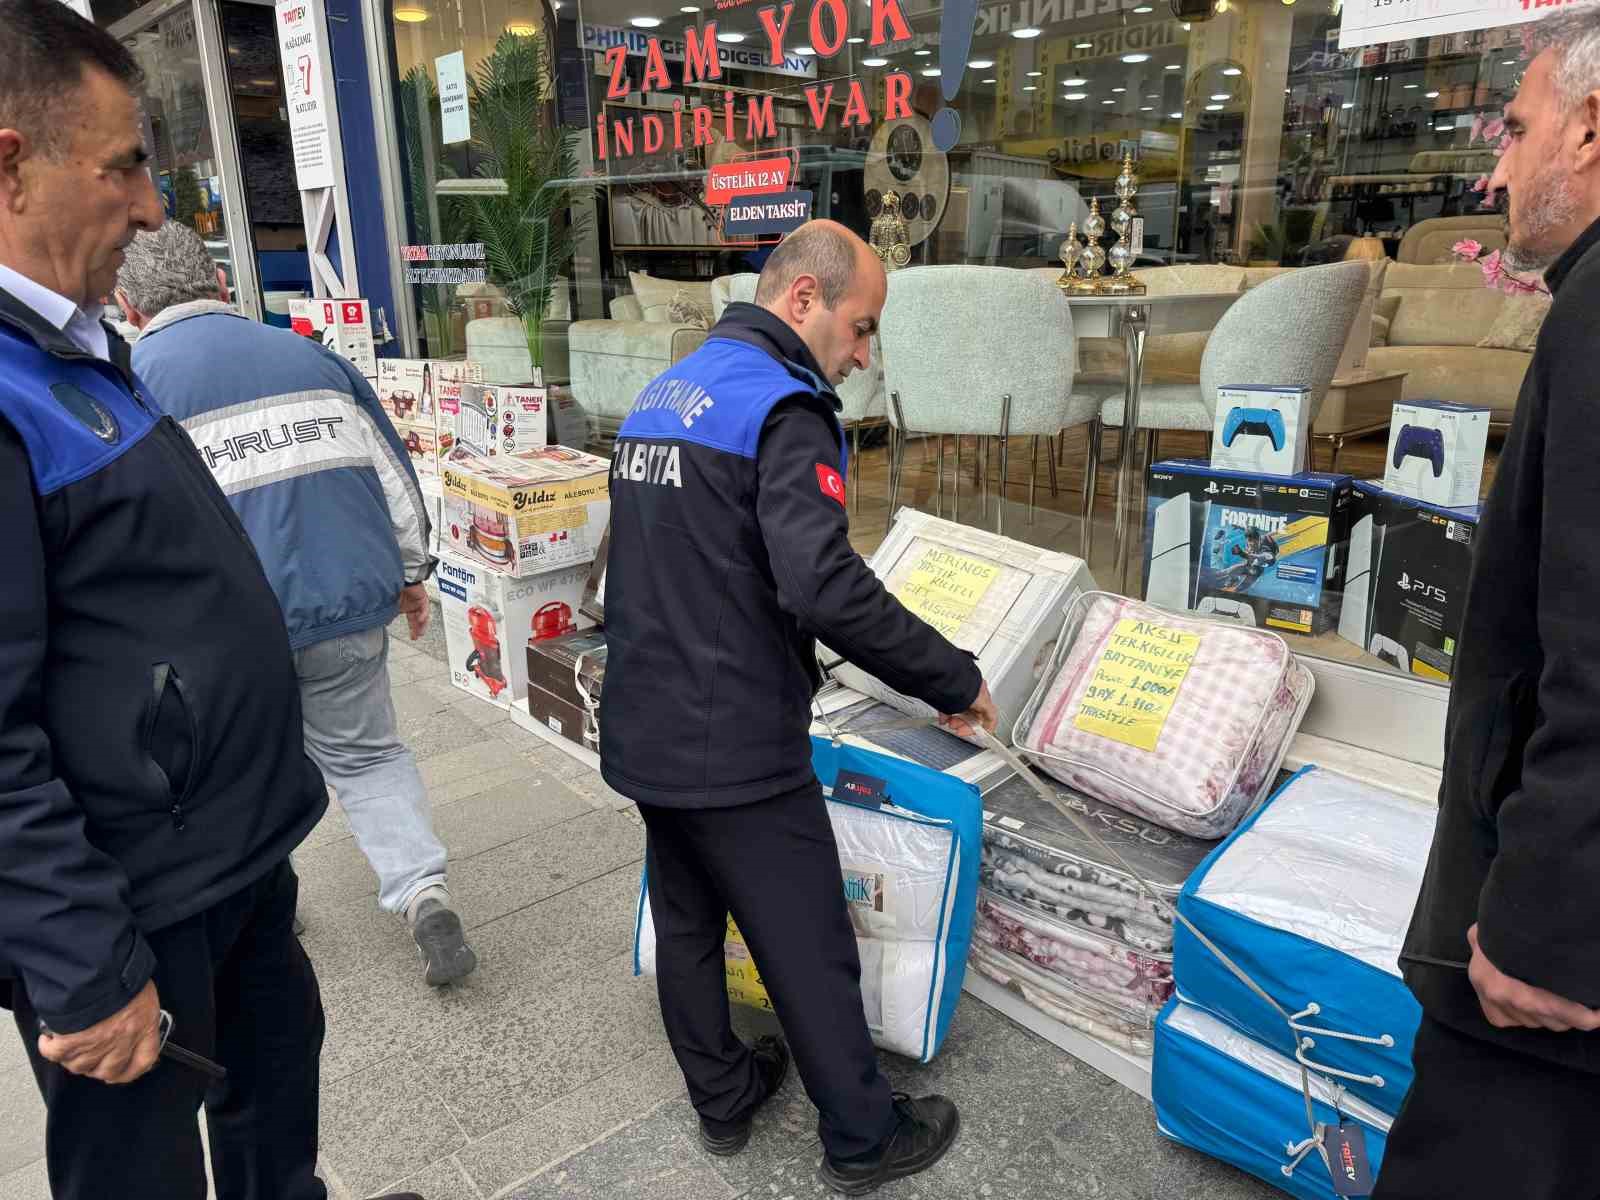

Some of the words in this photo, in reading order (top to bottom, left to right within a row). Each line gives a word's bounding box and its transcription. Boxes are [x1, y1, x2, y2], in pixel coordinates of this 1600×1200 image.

[585, 26, 648, 51] PHILIP
[758, 0, 913, 66] YOK
[604, 20, 721, 99] ZAM
[597, 91, 778, 160] İNDİRİM
[804, 72, 914, 130] VAR
[711, 170, 758, 191] ÜSTELİK
[759, 170, 769, 186] 12
[770, 169, 785, 185] AY
[730, 206, 764, 221] ELDEN
[766, 200, 806, 219] TAKSİT
[204, 416, 343, 469] HRUST
[613, 442, 682, 488] ZABITA
[1221, 509, 1288, 533] FORTNITE
[1413, 579, 1447, 602] PS5
